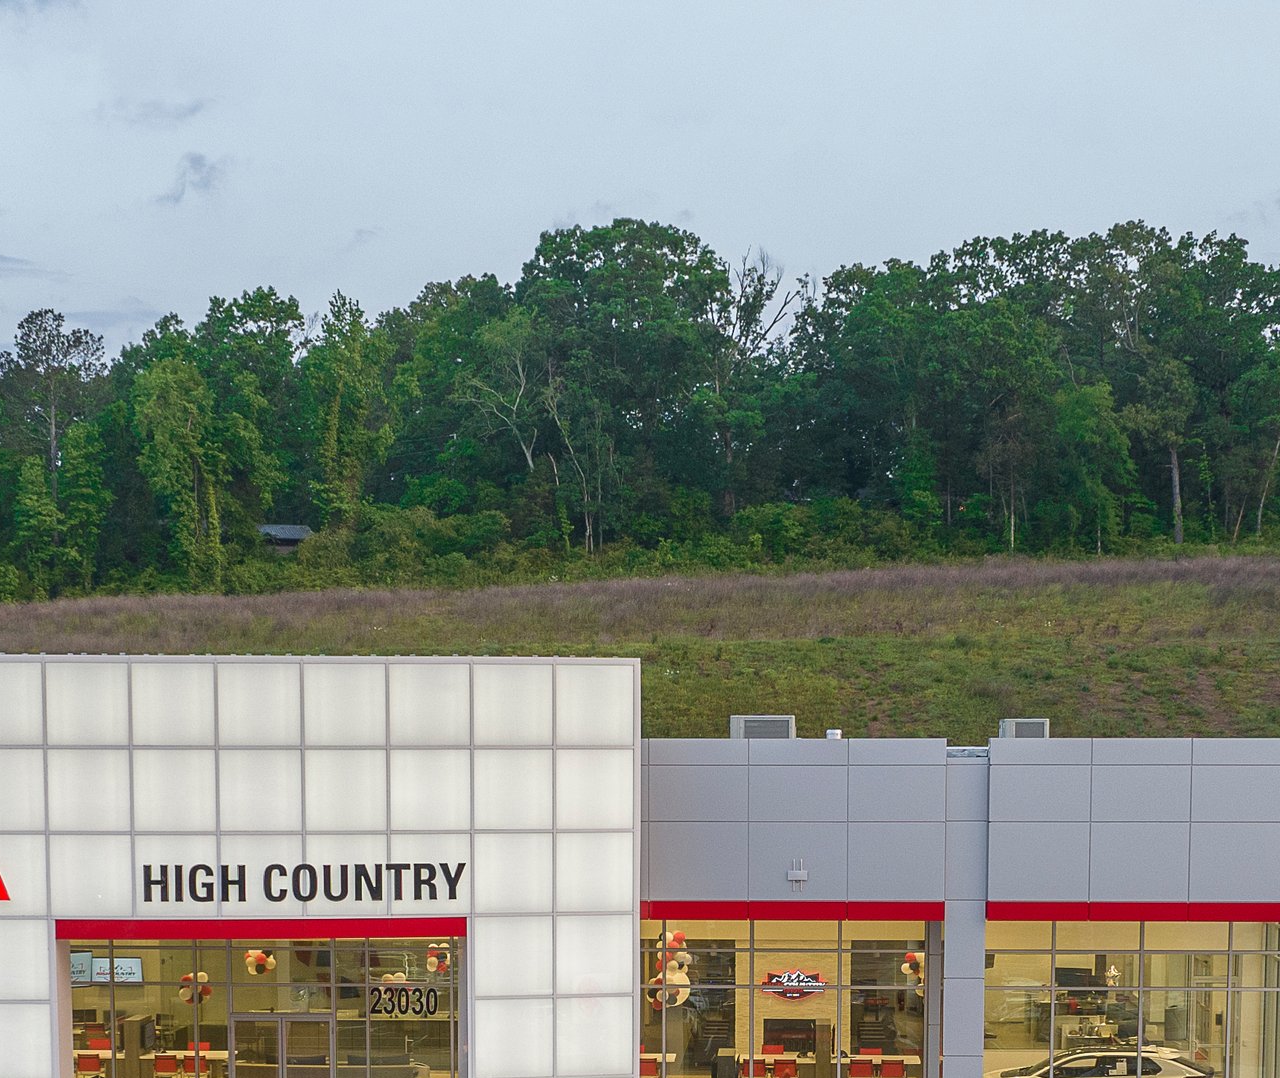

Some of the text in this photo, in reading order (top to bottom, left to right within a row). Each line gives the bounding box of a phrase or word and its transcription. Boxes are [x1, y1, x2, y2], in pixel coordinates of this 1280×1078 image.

[143, 862, 466, 902] HIGH COUNTRY
[370, 987, 438, 1015] 23030
